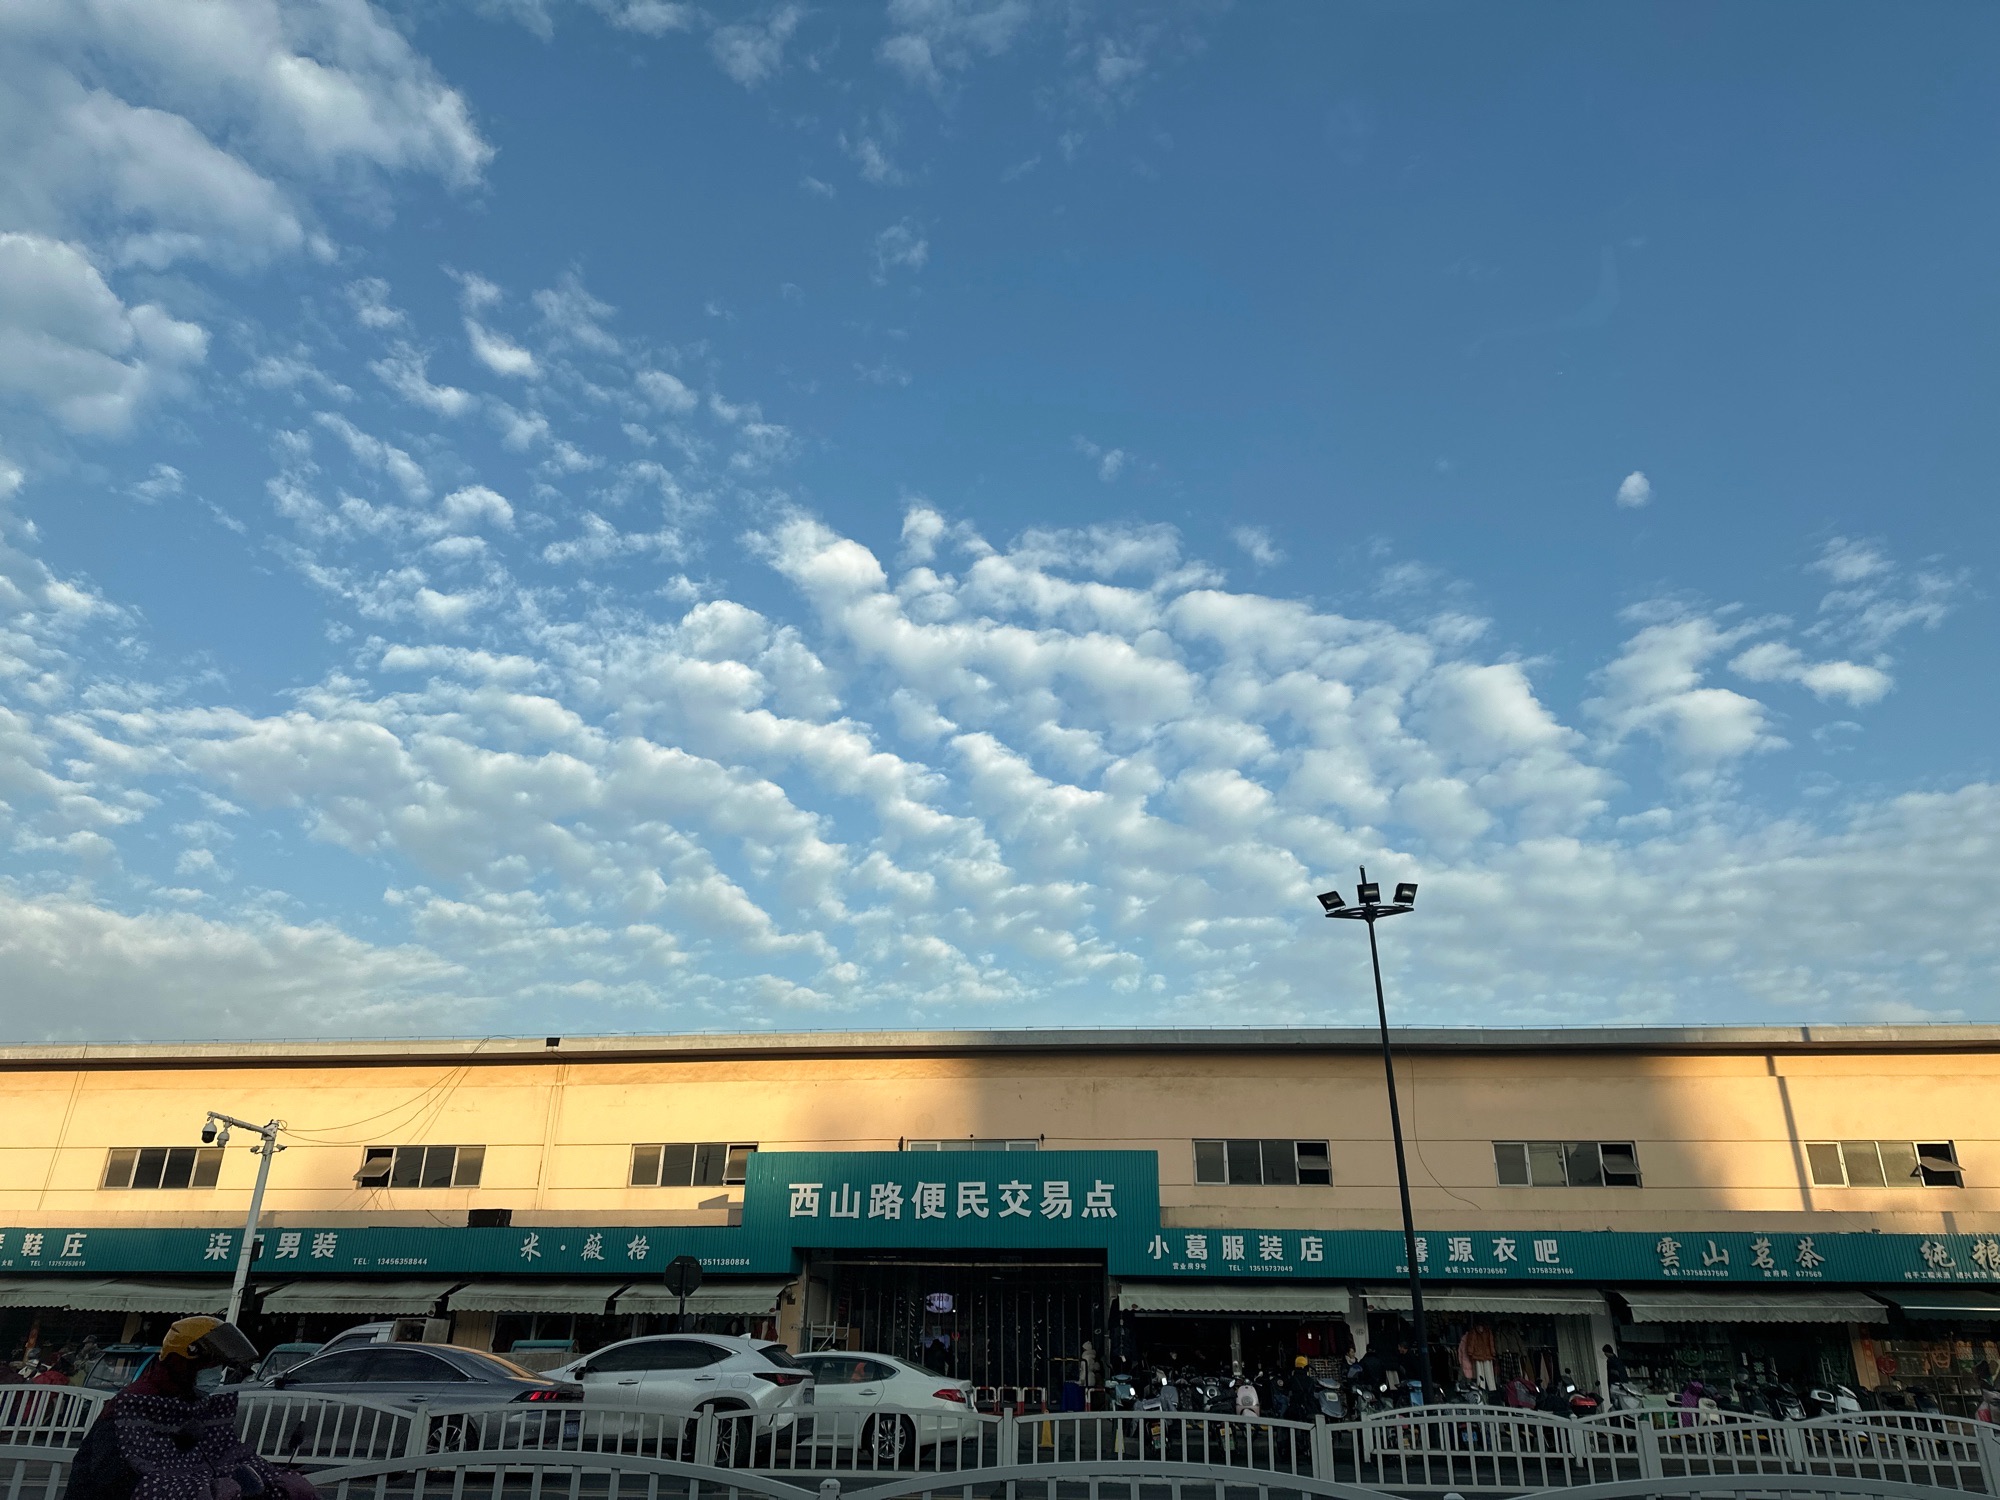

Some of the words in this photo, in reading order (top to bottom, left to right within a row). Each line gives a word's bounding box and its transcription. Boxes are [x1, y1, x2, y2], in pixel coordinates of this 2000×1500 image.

[788, 1179, 1118, 1220] 西山路便民交易点
[203, 1232, 339, 1260] 柒男装
[1147, 1234, 1324, 1262] 小葛服装店
[699, 1258, 750, 1266] 13511380884
[1229, 1264, 1244, 1272] TEL:
[1249, 1264, 1293, 1272] 13515737049
